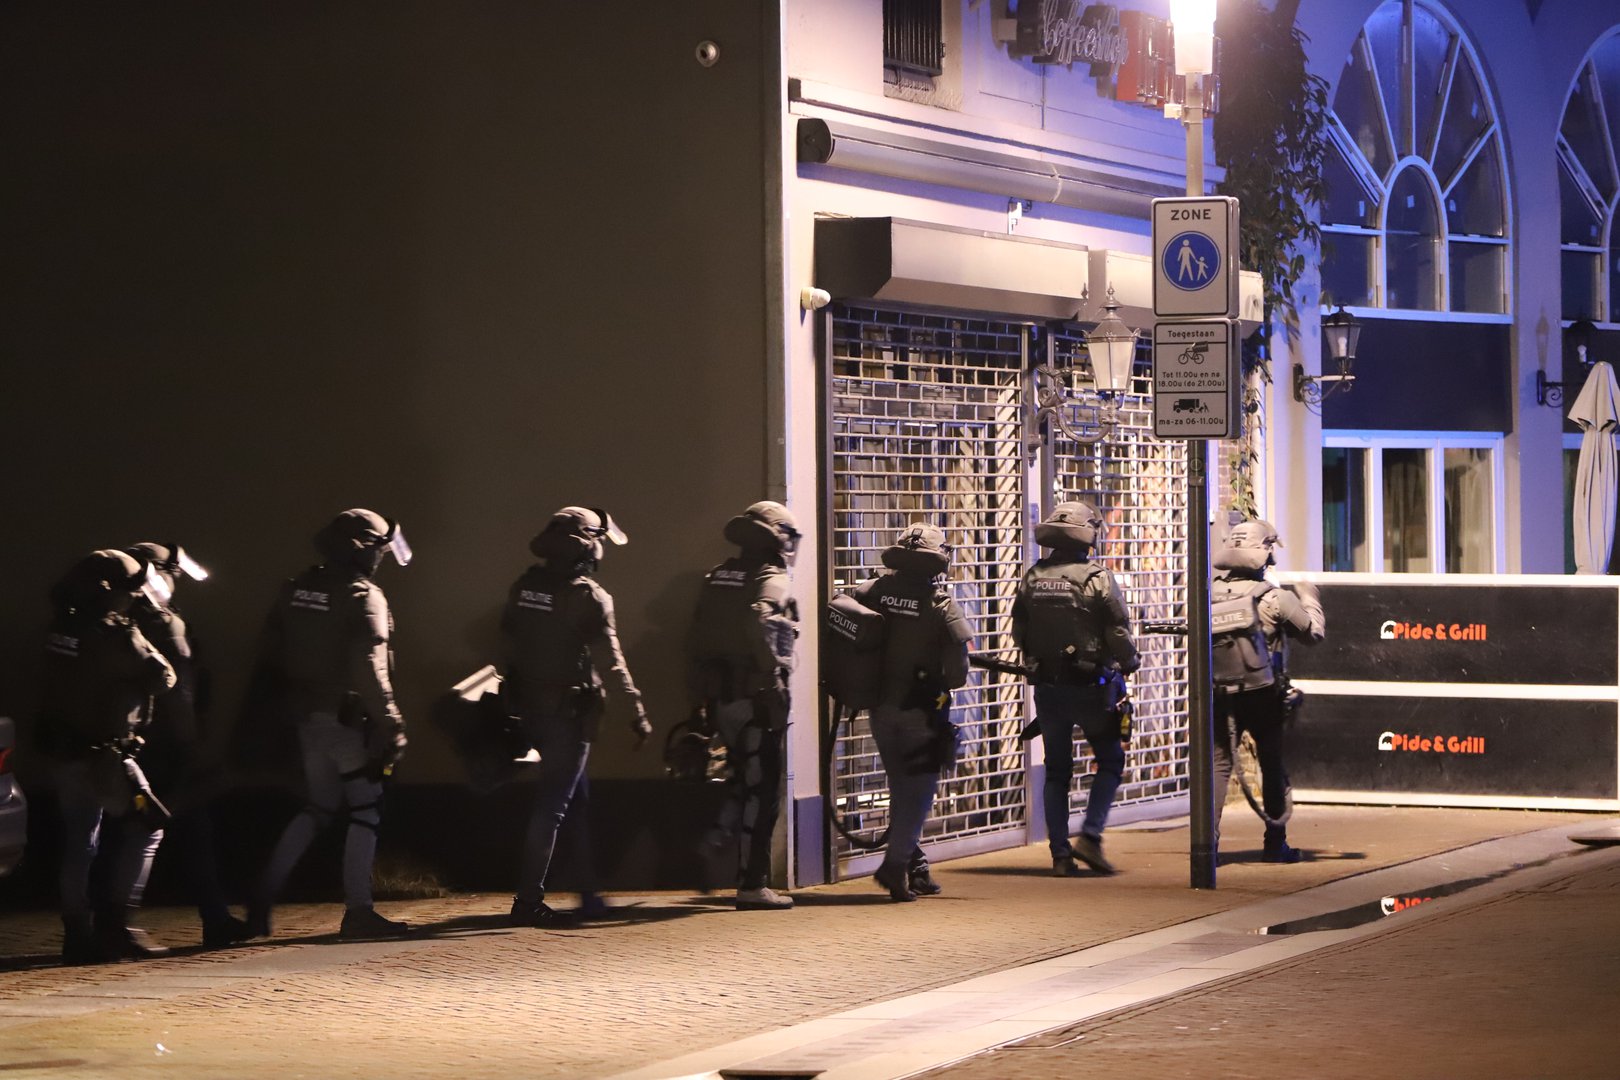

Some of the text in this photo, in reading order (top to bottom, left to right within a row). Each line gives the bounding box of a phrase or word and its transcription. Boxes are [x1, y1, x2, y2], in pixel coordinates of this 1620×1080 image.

[1170, 209, 1212, 221] ZONE
[1168, 330, 1215, 339] Toegestaan
[1185, 417, 1224, 425] 06-11.00u
[1036, 581, 1071, 591] POLITIE
[880, 595, 919, 609] POLITIE
[829, 611, 858, 634] POLITIE
[1393, 623, 1434, 640] Pide
[1449, 624, 1487, 641] Grill
[1391, 733, 1432, 752] Pide
[1447, 736, 1485, 754] Grill
